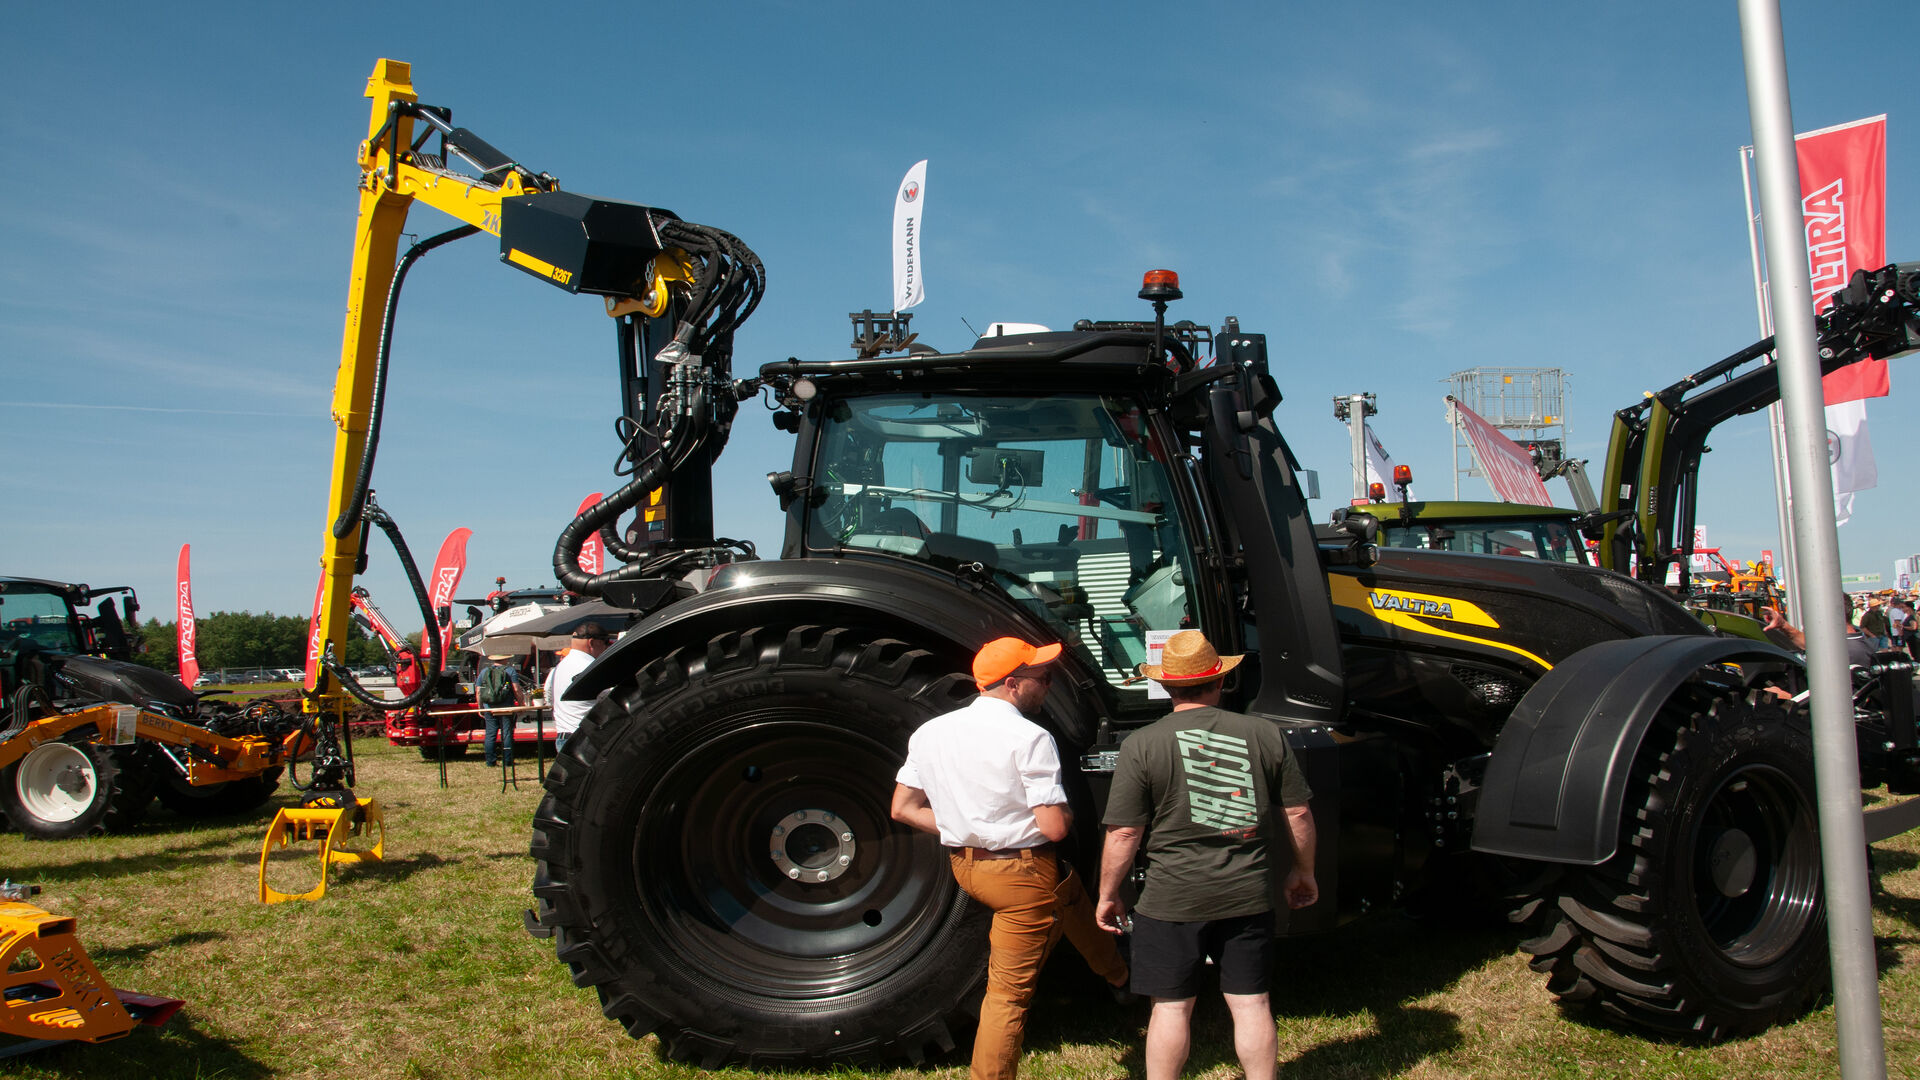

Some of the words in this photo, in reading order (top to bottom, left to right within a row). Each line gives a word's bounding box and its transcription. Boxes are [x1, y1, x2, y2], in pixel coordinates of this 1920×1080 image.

[905, 217, 914, 300] WEIDEMANN
[552, 267, 572, 285] 326T
[1694, 529, 1704, 562] SEYR
[1369, 592, 1453, 619] VALTRA
[179, 581, 196, 663] VALTRA
[143, 714, 173, 730] BERKY
